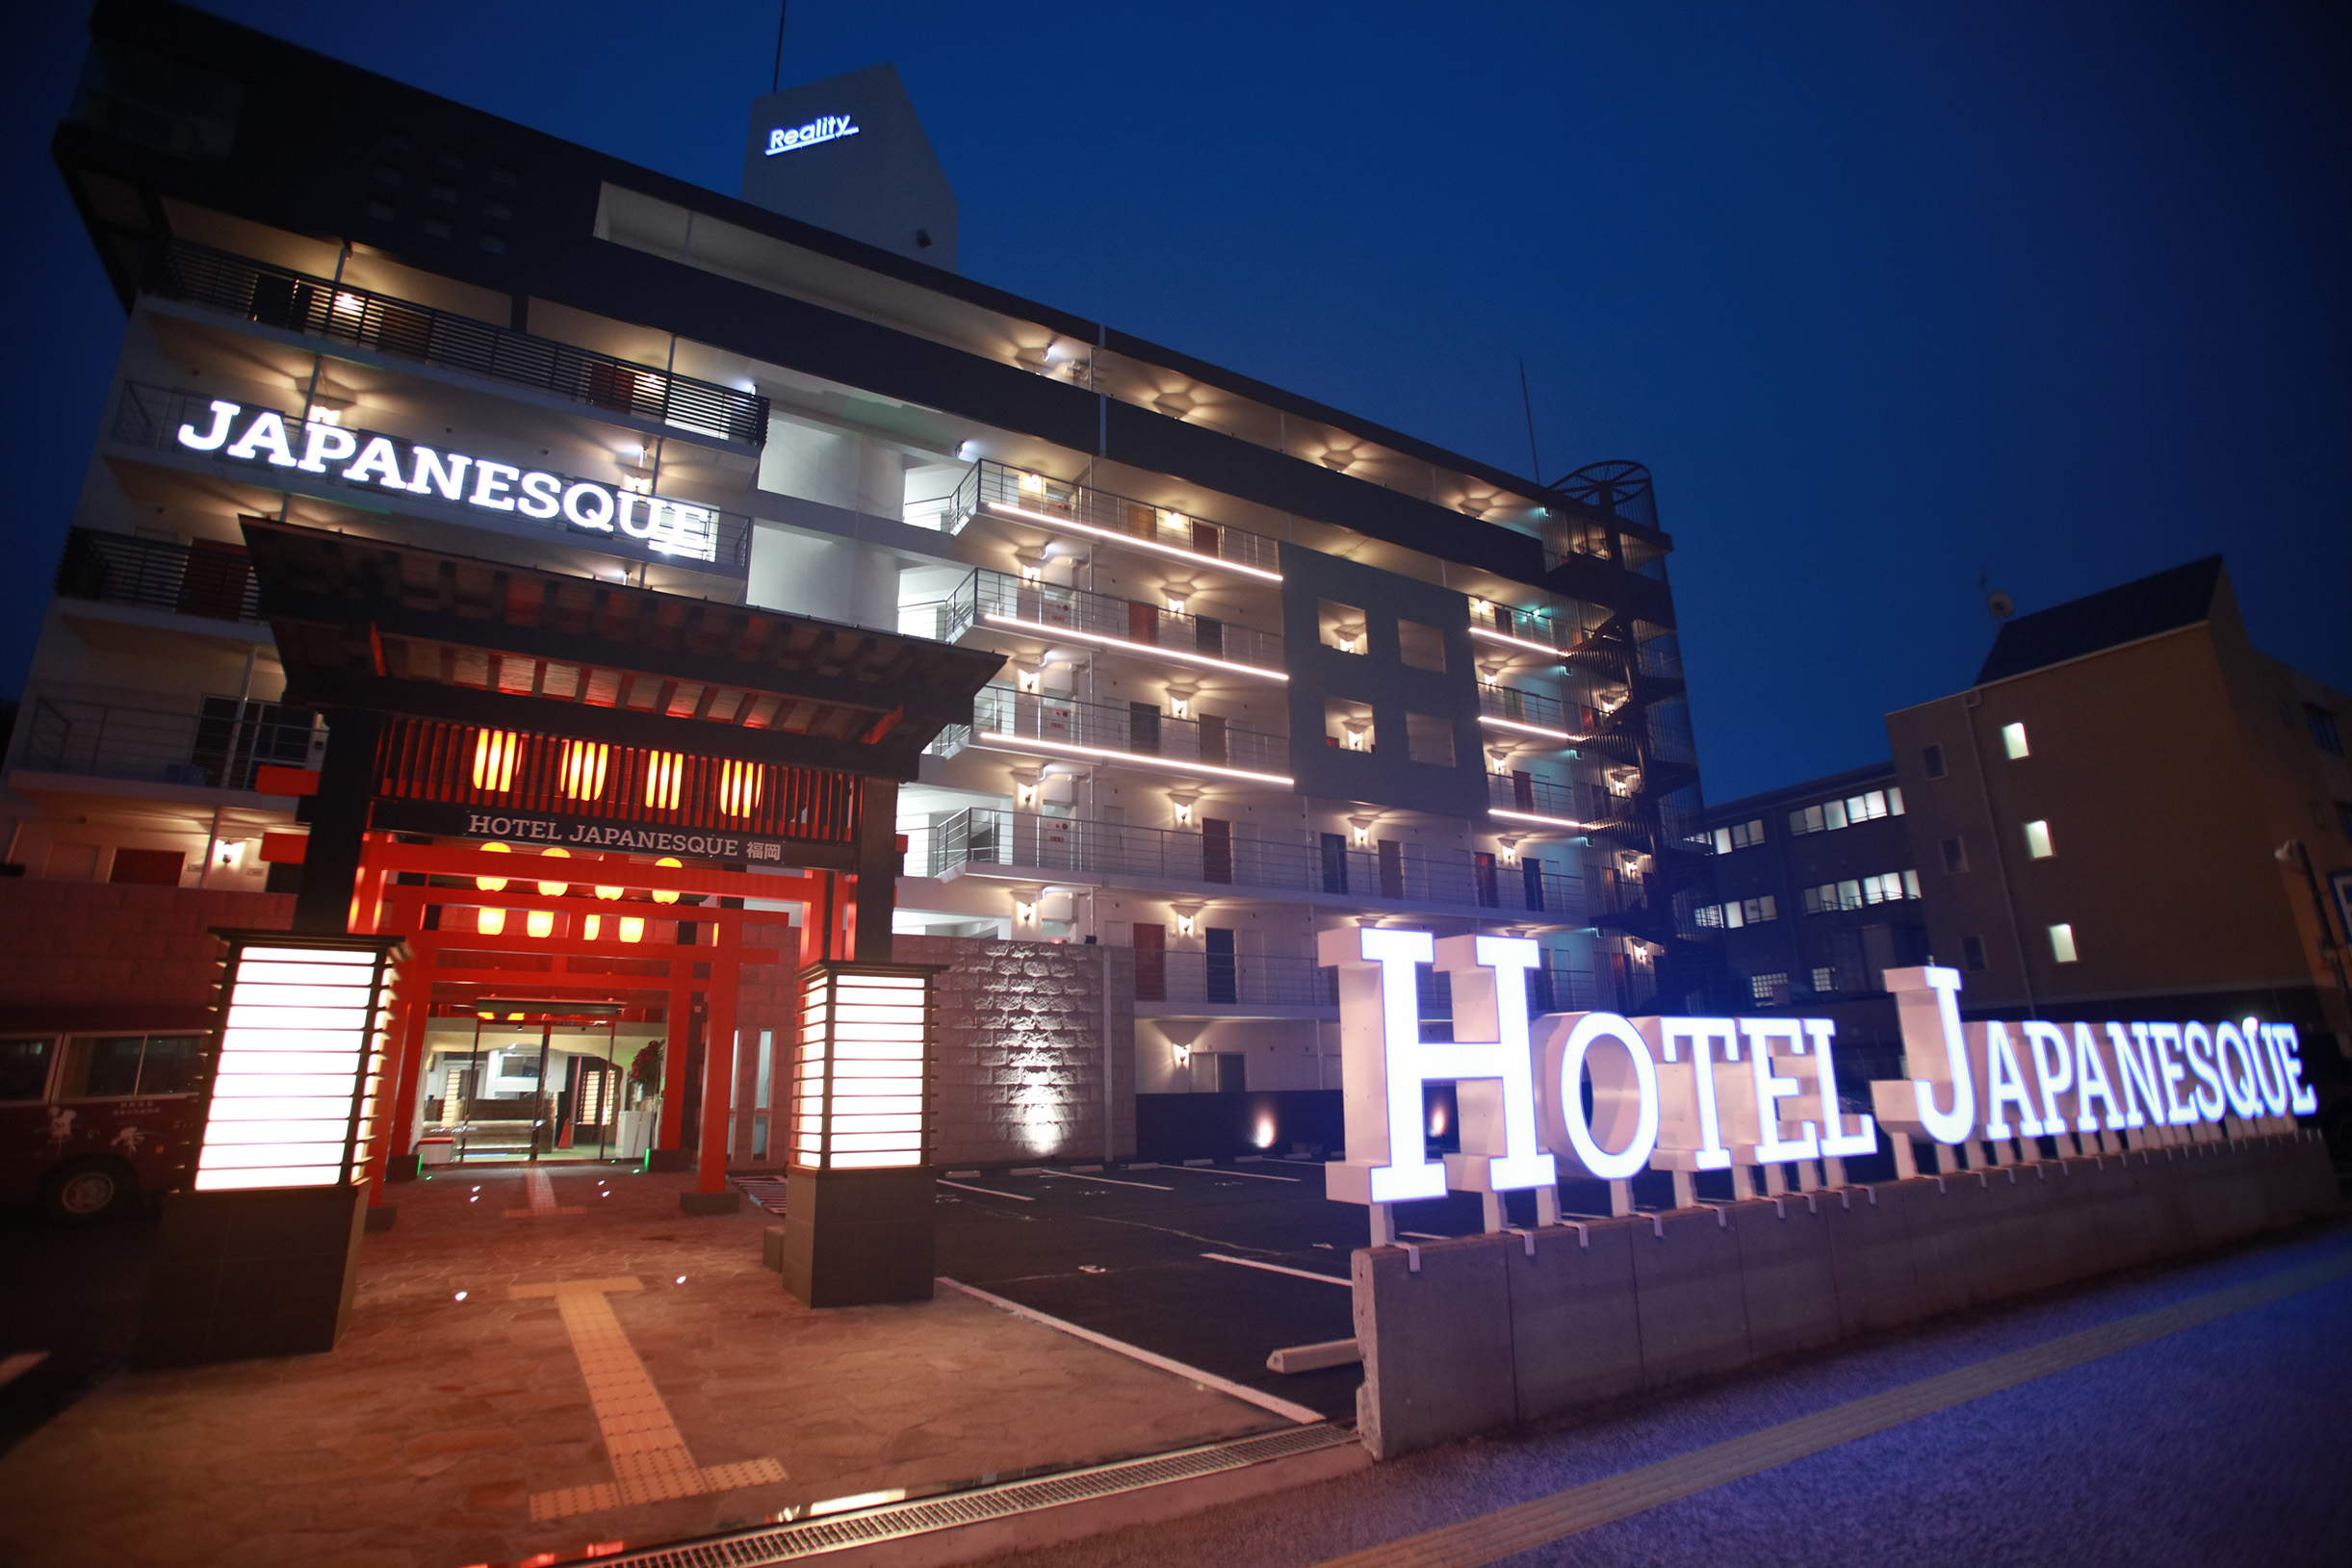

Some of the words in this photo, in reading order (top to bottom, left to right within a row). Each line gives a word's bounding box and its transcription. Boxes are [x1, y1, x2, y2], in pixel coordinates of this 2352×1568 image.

[768, 114, 852, 149] Reality
[177, 399, 711, 553] JAPANESQUE
[468, 814, 562, 840] HOTEL
[569, 825, 738, 856] JAPANESQUE
[746, 840, 781, 861] 福岡
[1359, 927, 1877, 1203] HOTEL
[1913, 965, 2317, 1144] JAPANESQUE
